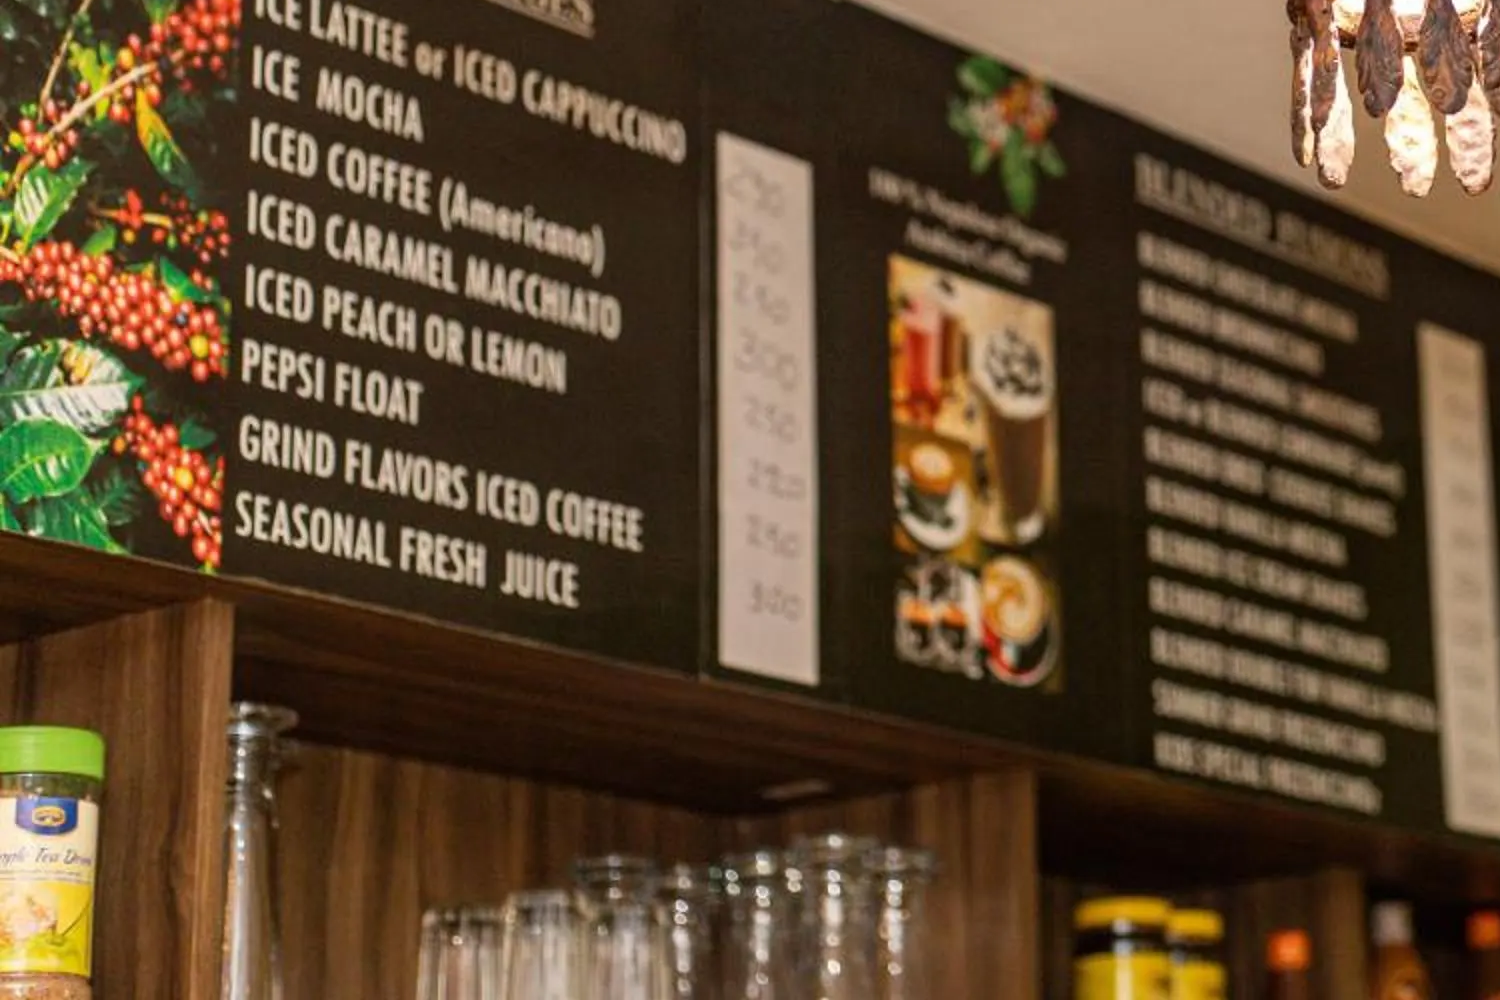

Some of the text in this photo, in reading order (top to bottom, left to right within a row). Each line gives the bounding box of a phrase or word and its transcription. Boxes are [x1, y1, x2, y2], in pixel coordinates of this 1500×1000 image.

[252, 45, 424, 142] ICE MOCHA
[415, 42, 448, 80] or
[454, 44, 516, 104] ICED
[522, 70, 687, 164] CAPPUCCINO
[249, 117, 606, 278] ICED COFFEE (Americano)
[247, 190, 622, 340] ICED CARAMEL MACCHIATO
[241, 339, 424, 426] PEPSI FLOAT
[245, 264, 567, 394] ICED PEACH OR LEMON
[239, 415, 644, 552] GRIND FLAVORS ICED COFFEE
[235, 491, 580, 609] SEASONAL FRESH JUICE
